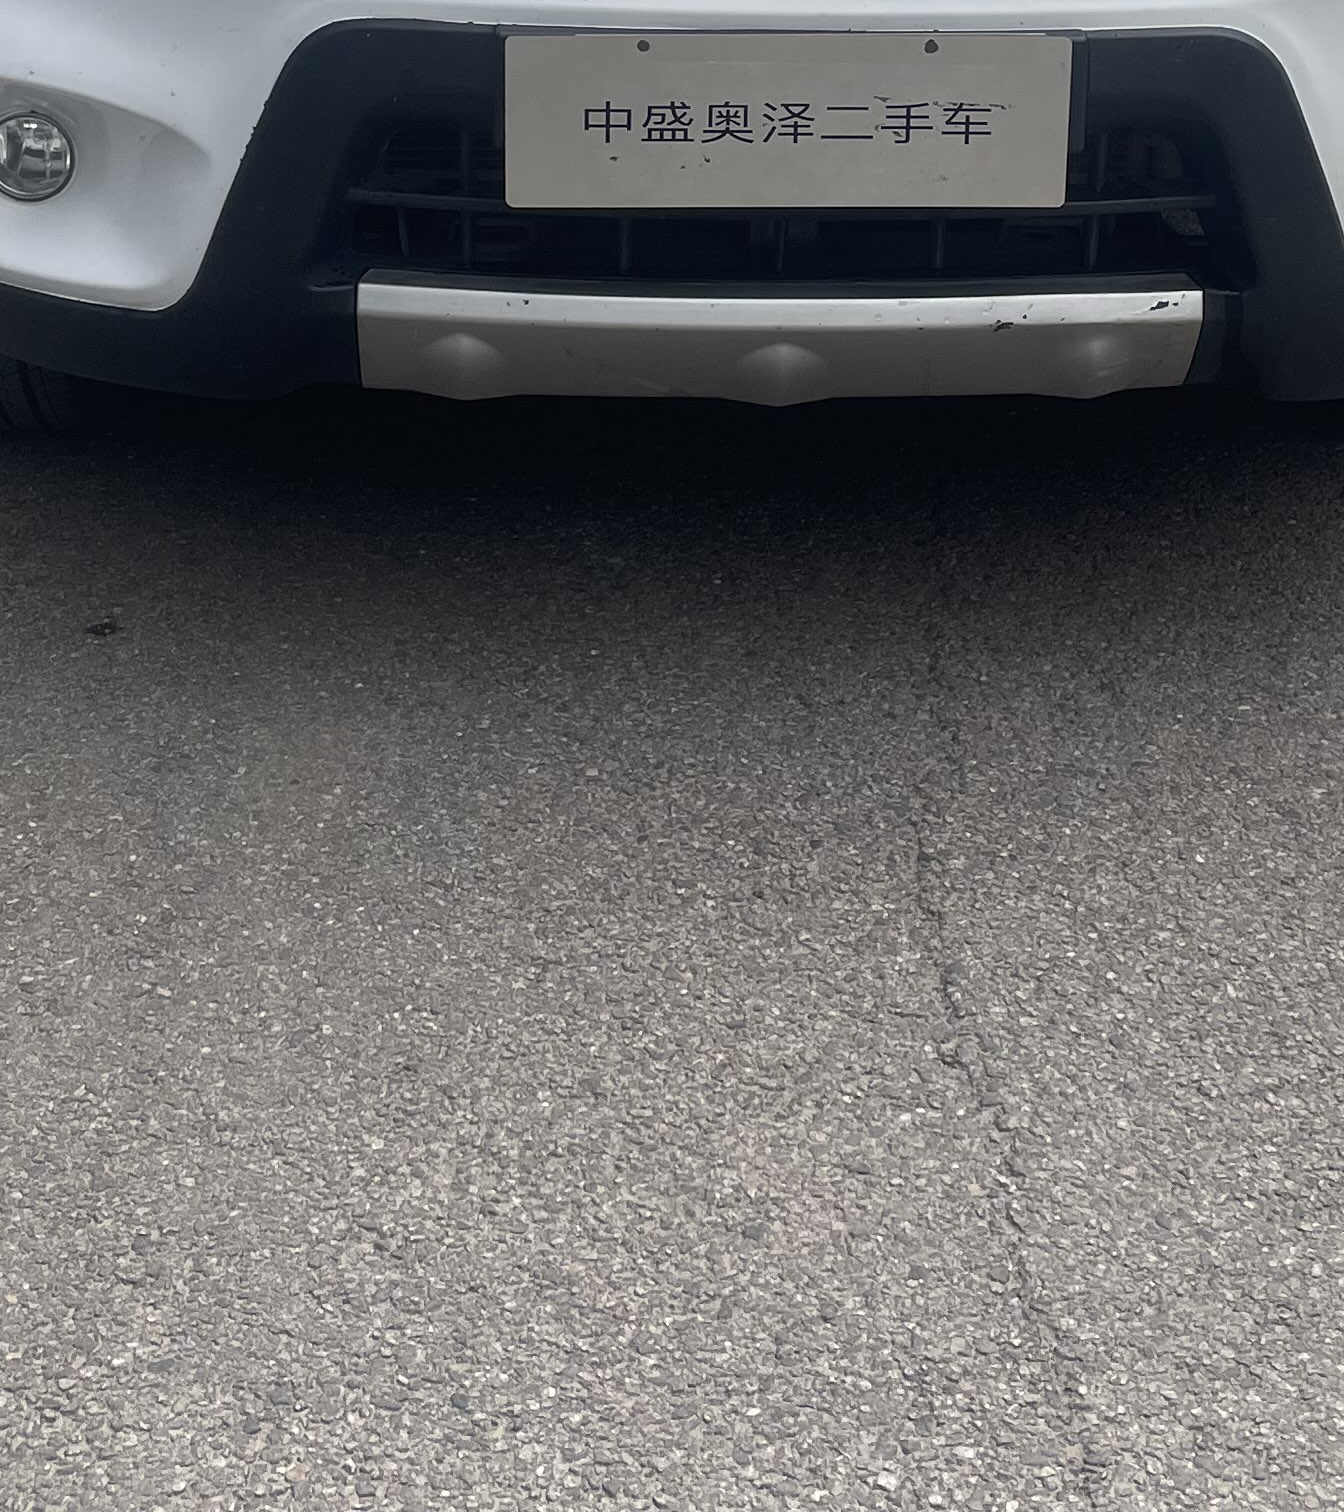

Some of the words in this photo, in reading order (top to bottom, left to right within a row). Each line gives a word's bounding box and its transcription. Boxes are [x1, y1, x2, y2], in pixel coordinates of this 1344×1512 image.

[582, 100, 993, 145] 中盛奥泽二手车
